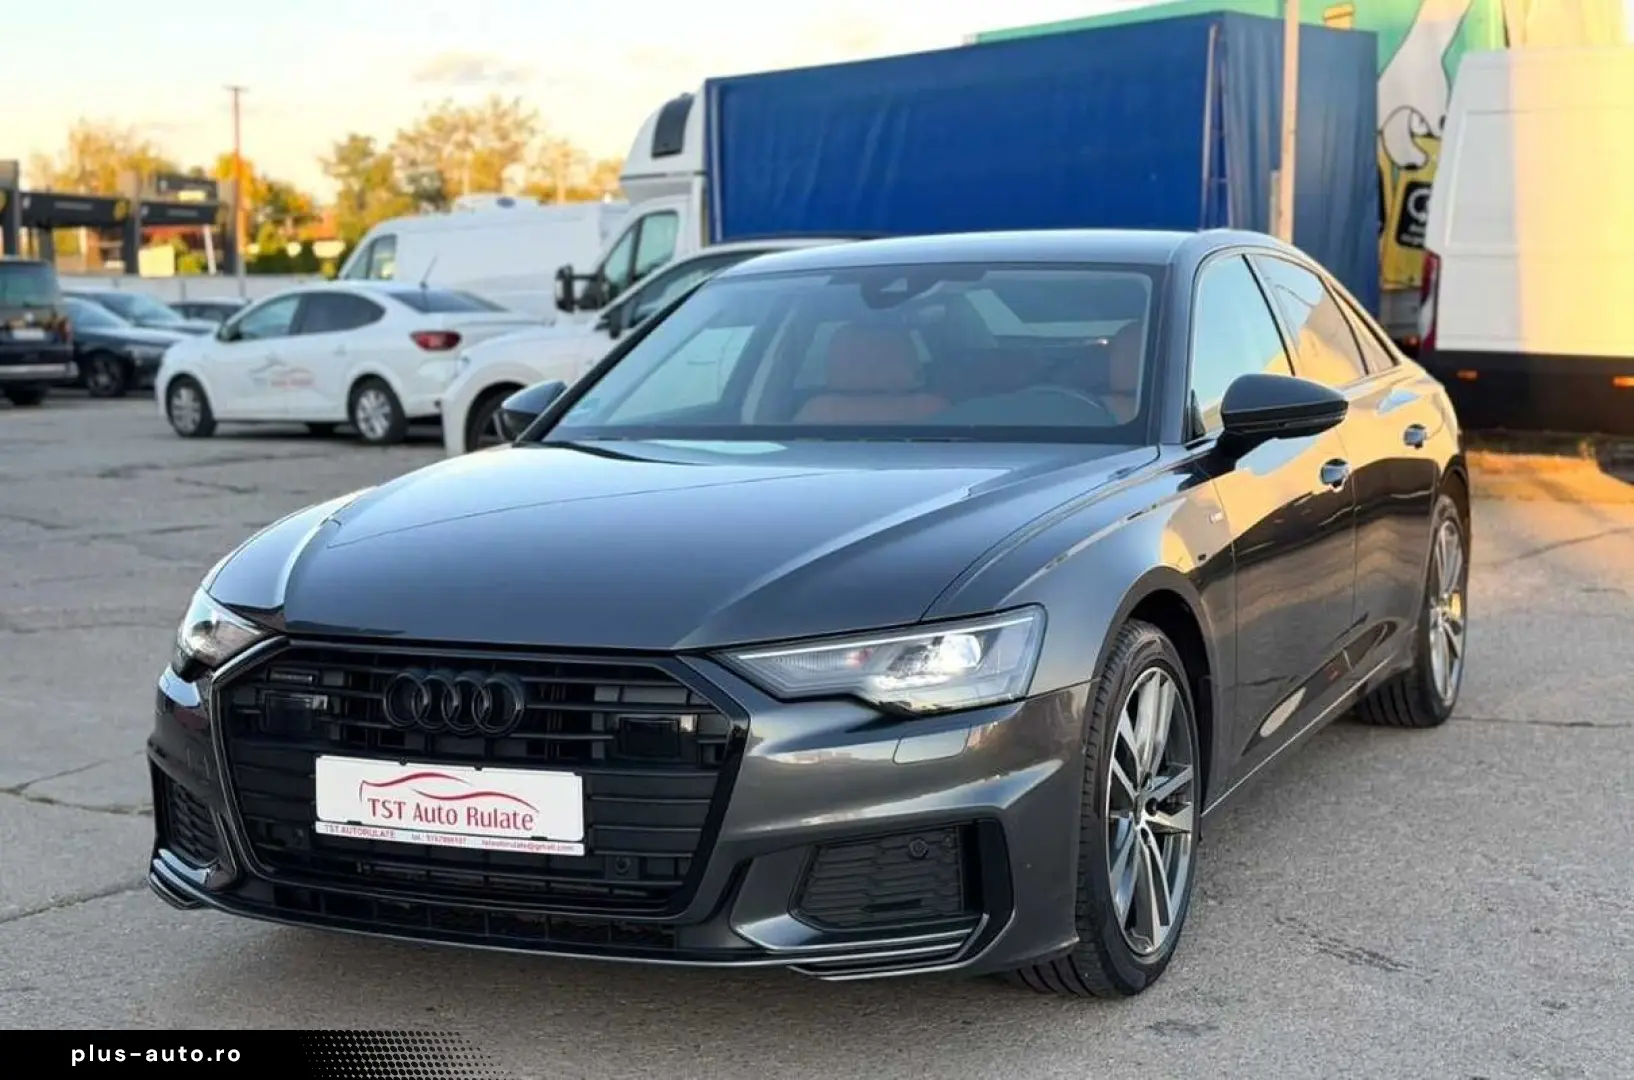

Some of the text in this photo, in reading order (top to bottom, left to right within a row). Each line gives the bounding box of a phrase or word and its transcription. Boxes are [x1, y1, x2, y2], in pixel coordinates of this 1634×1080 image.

[367, 797, 534, 831] TST Auto Rulate
